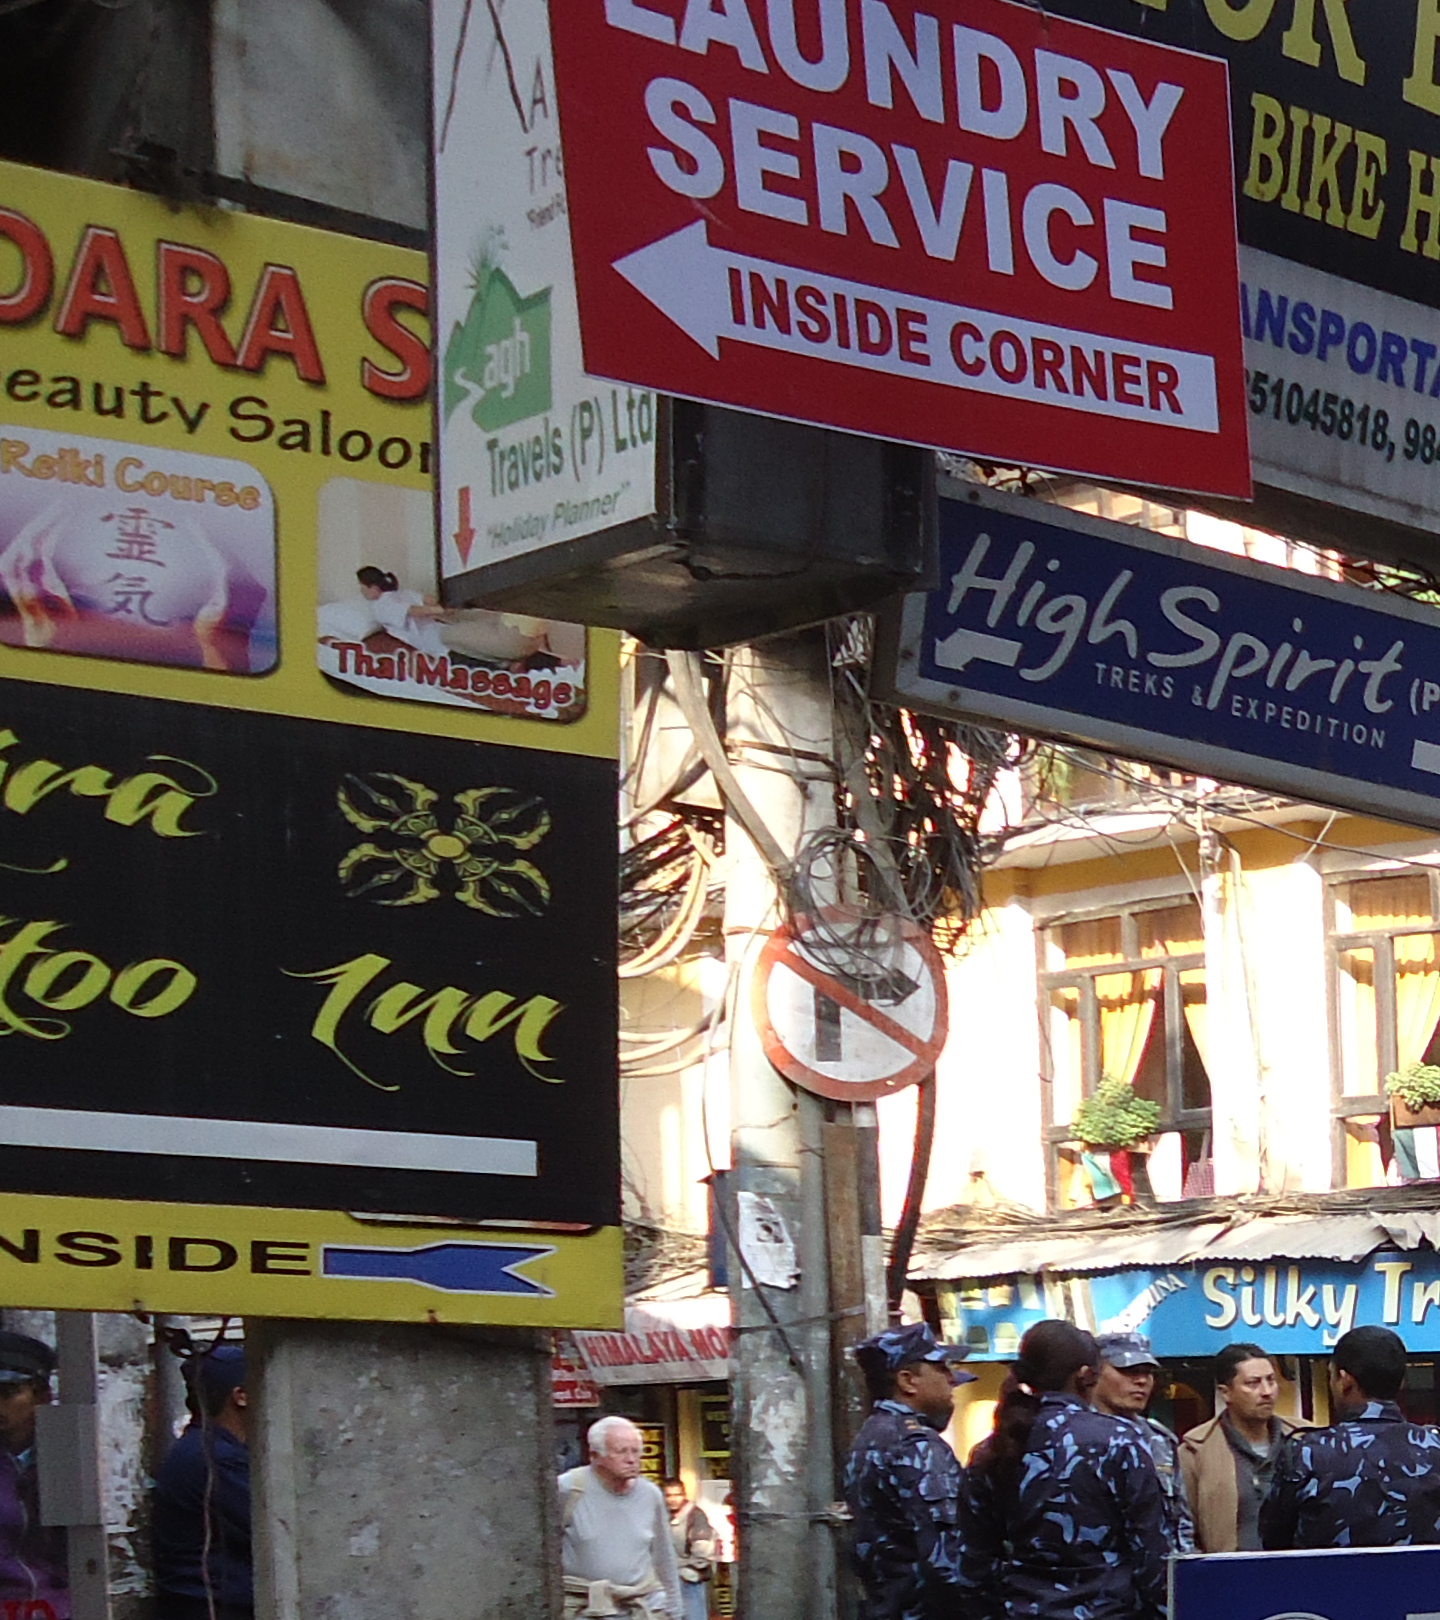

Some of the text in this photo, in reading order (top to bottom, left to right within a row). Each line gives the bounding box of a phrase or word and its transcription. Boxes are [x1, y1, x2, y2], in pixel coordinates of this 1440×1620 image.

[644, 77, 1174, 310] SERVICE
[1243, 92, 1390, 240] BIKE
[727, 266, 1183, 415] INSIDE CORNER
[3, 366, 210, 434] eauty
[486, 417, 564, 497] Travels
[571, 395, 604, 482] (P)
[0, 438, 260, 511] Reiki Course
[946, 533, 1139, 682] High
[1148, 585, 1404, 715] Spirit
[331, 641, 574, 710] Thai Massage
[1096, 662, 1387, 750] TREKS & EXPEDITION
[1202, 1265, 1357, 1347] Silky
